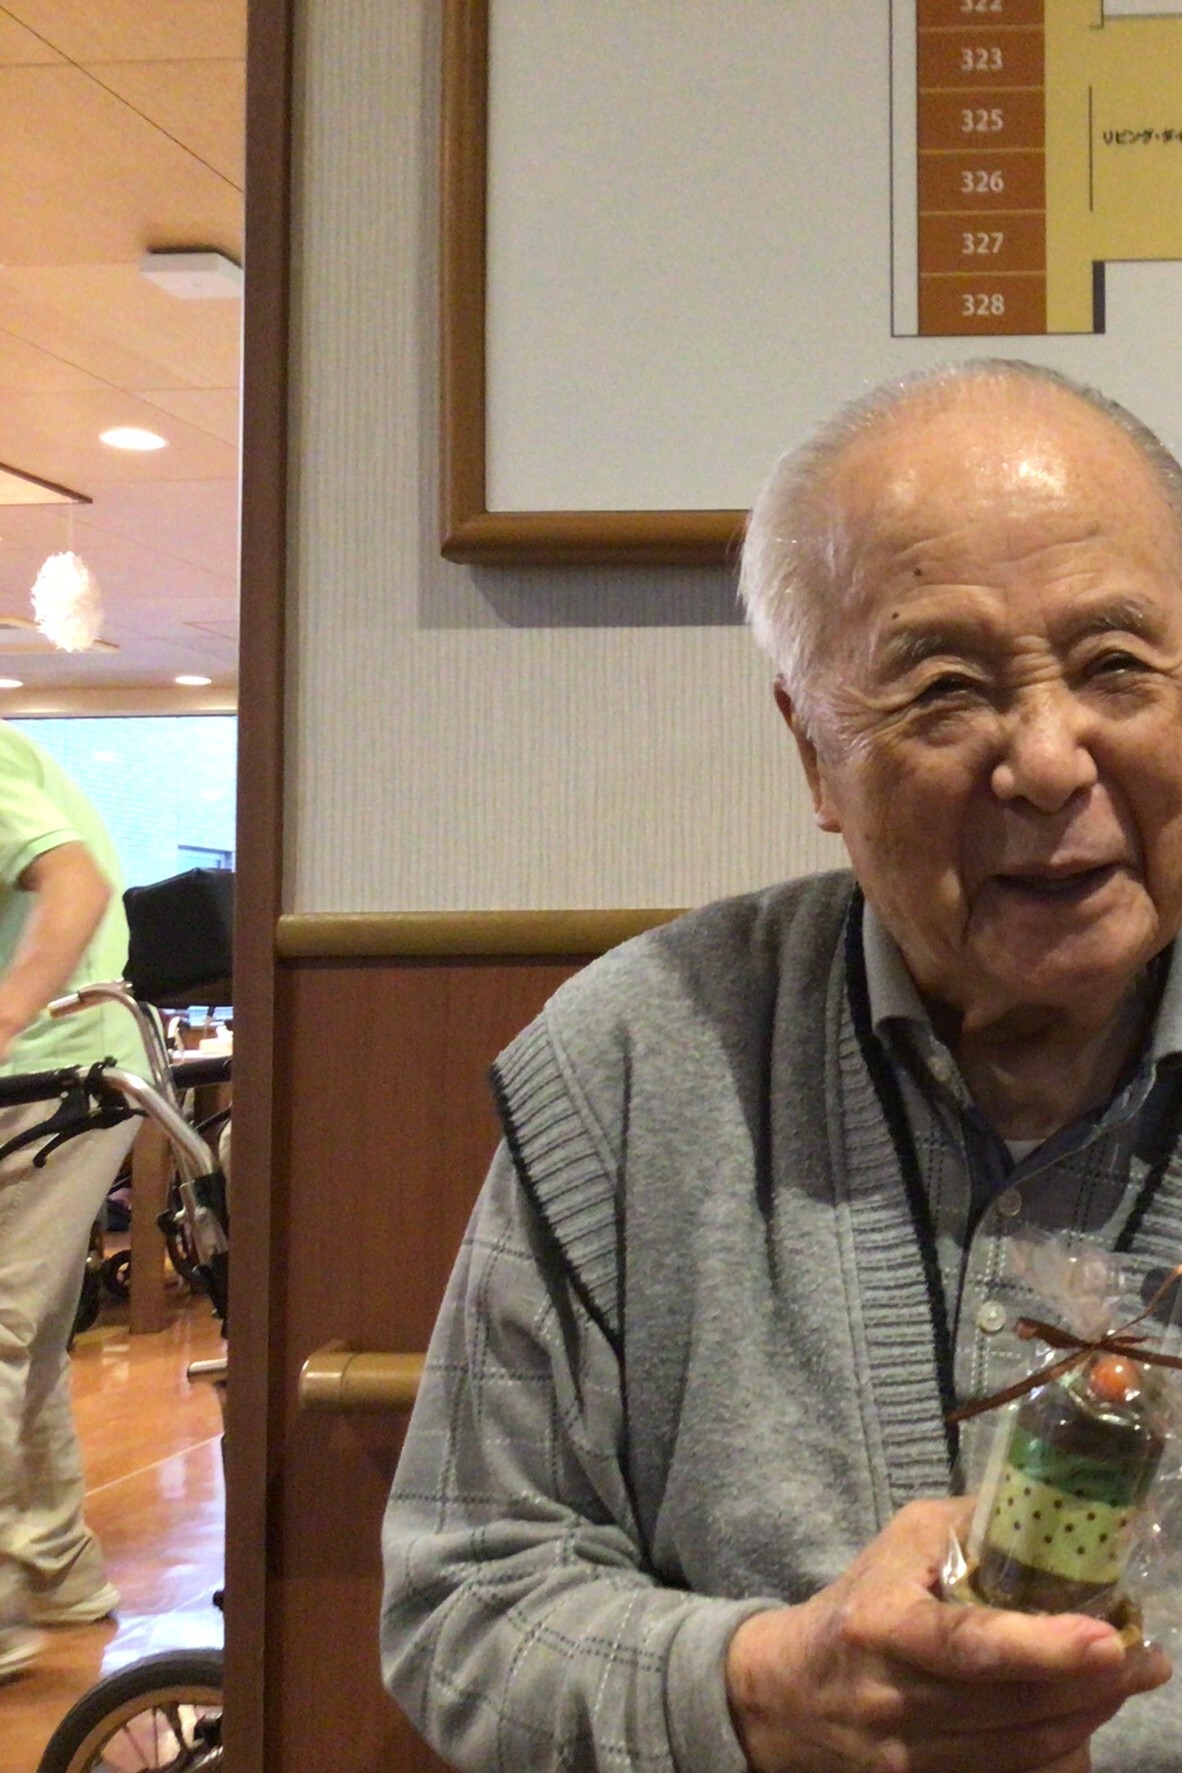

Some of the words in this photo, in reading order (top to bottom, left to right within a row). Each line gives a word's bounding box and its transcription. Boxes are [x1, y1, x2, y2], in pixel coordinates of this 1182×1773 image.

[961, 47, 1003, 71] 323
[961, 108, 1004, 132] 325
[961, 170, 1004, 193] 326
[962, 232, 1004, 255] 327
[962, 293, 1005, 316] 328
